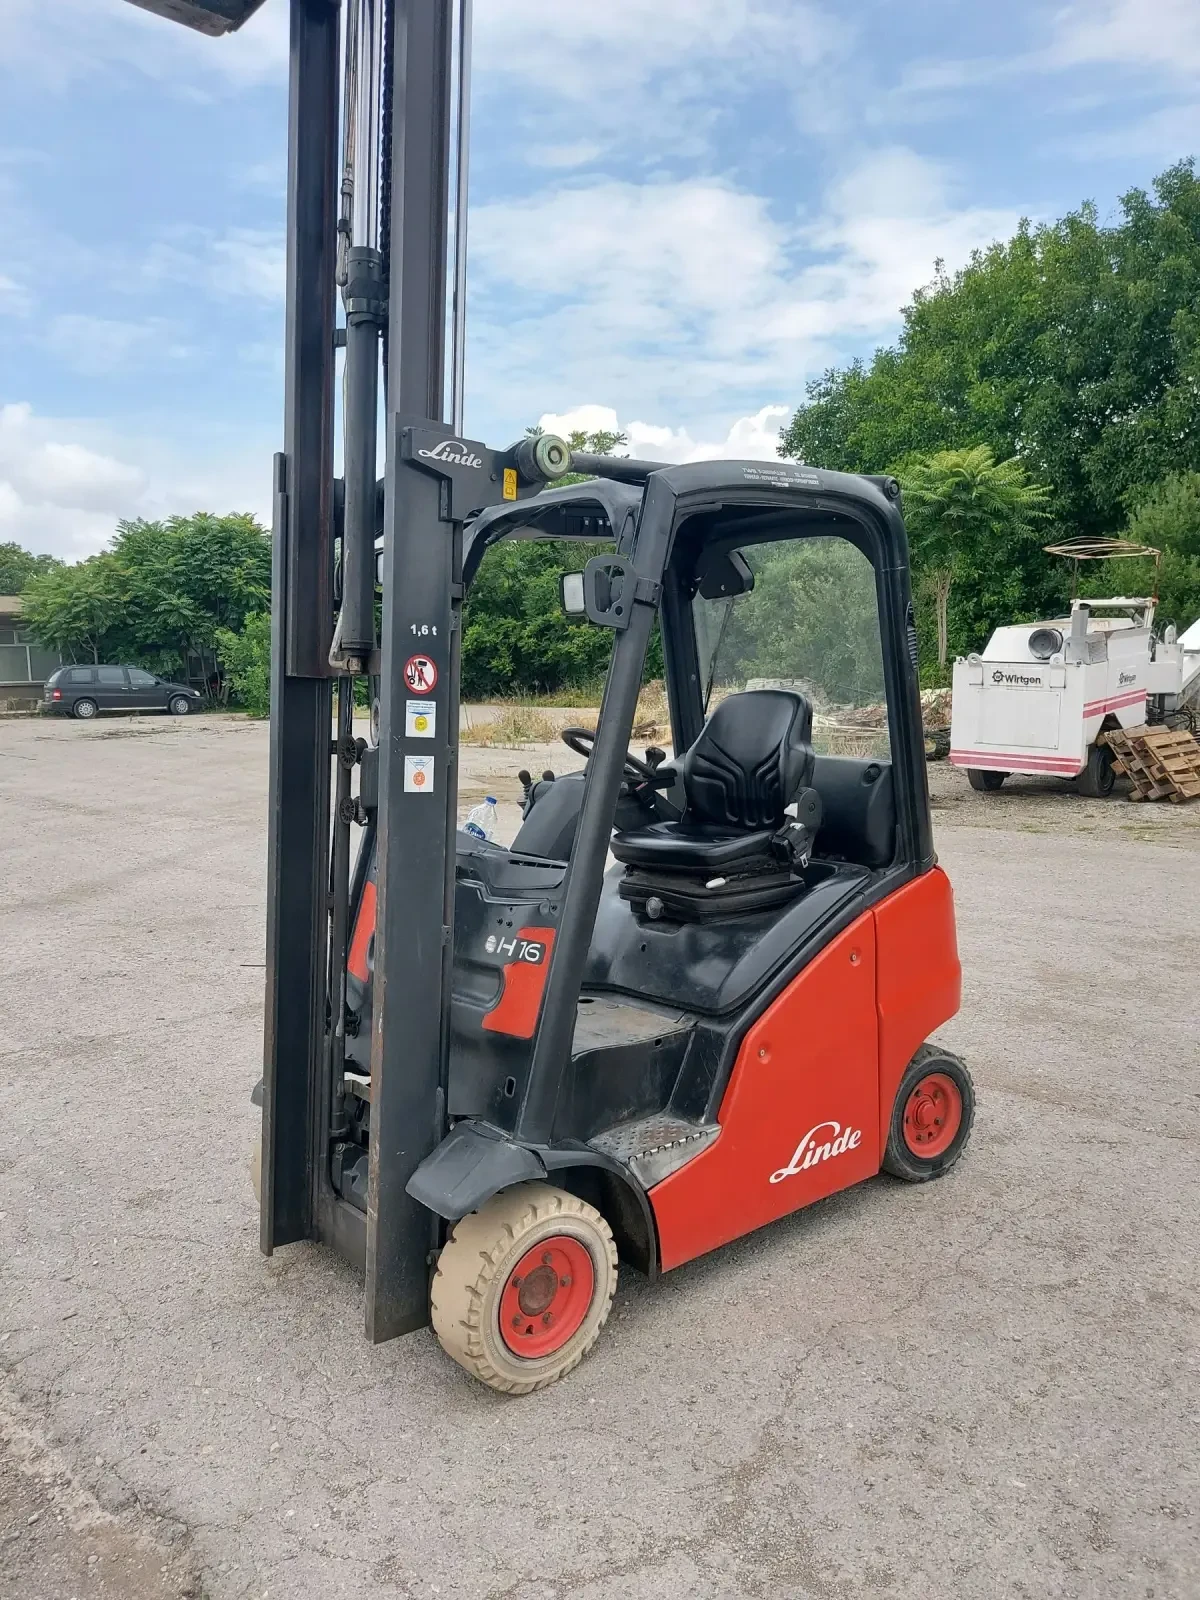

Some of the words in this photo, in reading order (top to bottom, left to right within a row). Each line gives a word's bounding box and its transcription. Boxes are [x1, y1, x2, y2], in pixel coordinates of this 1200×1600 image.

[418, 440, 482, 469] Linde
[410, 624, 429, 637] 1,6
[432, 625, 437, 636] t
[1004, 674, 1042, 686] Wirtgen
[496, 936, 518, 957] H
[518, 941, 542, 962] 16
[769, 1121, 862, 1184] Linde
